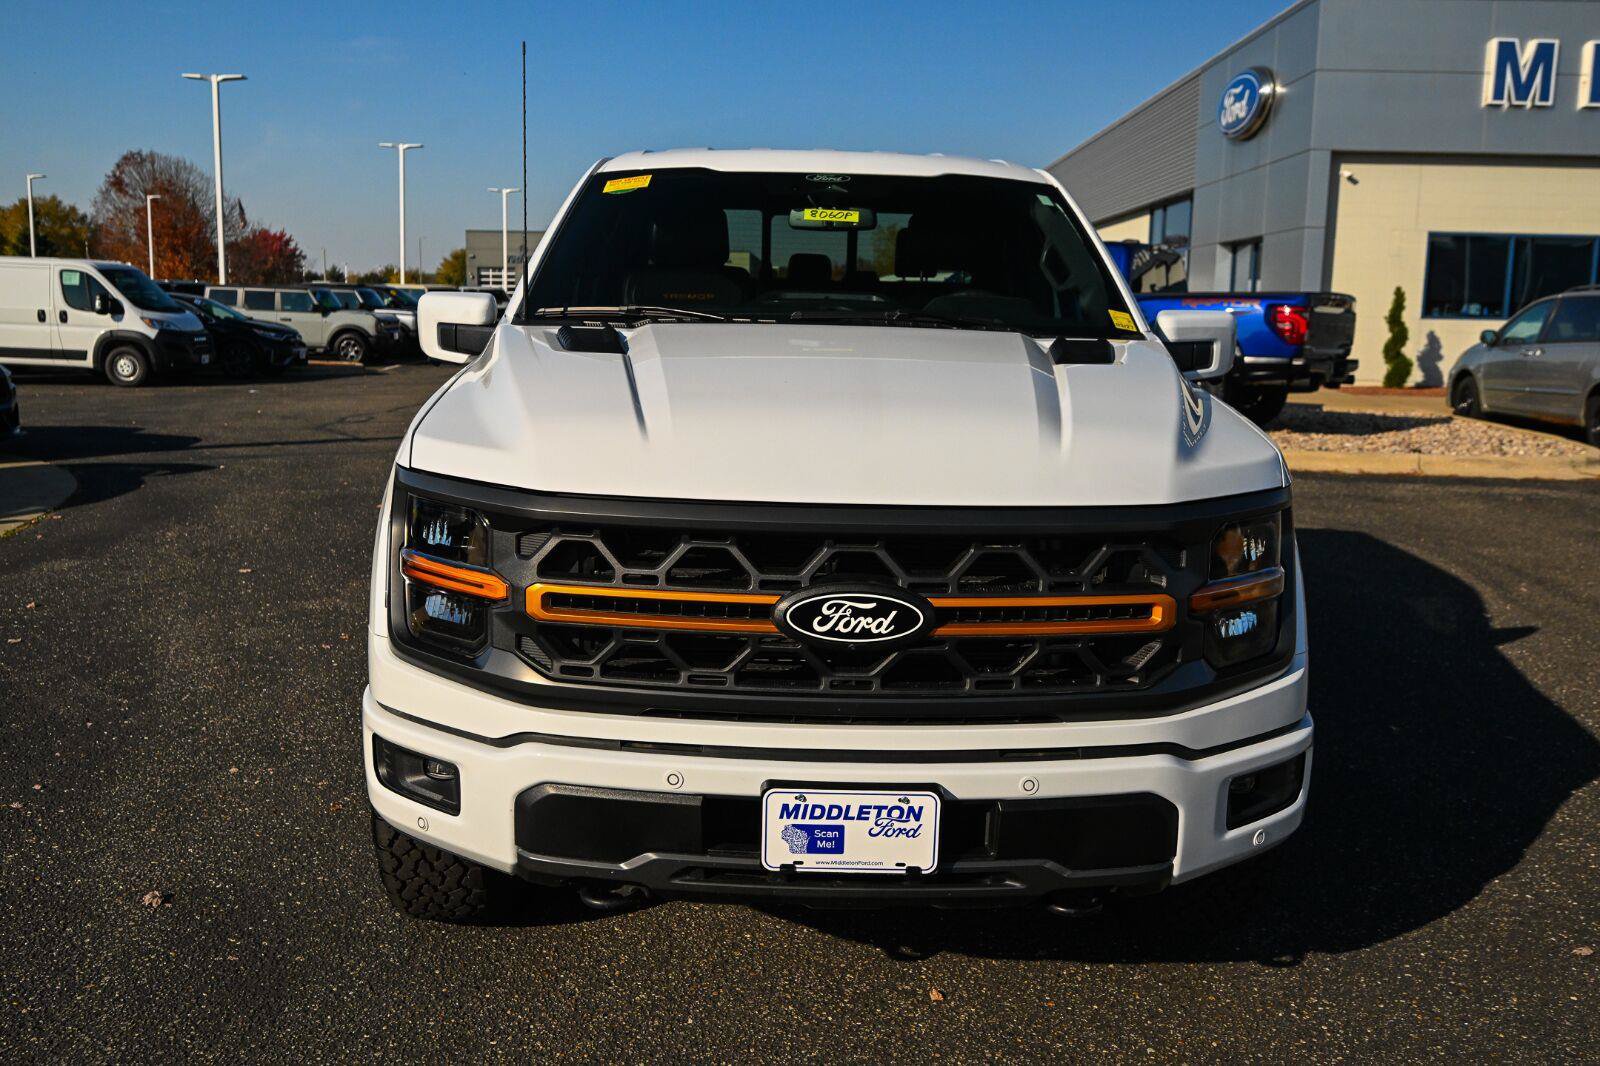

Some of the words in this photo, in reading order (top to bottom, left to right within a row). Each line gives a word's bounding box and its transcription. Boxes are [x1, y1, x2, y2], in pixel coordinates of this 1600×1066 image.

[1221, 84, 1250, 127] Ford
[812, 600, 898, 635] Ford
[779, 803, 924, 822] MIDDLETON
[814, 829, 839, 838] Scan
[868, 817, 923, 839] Ford
[816, 840, 835, 848] Me!
